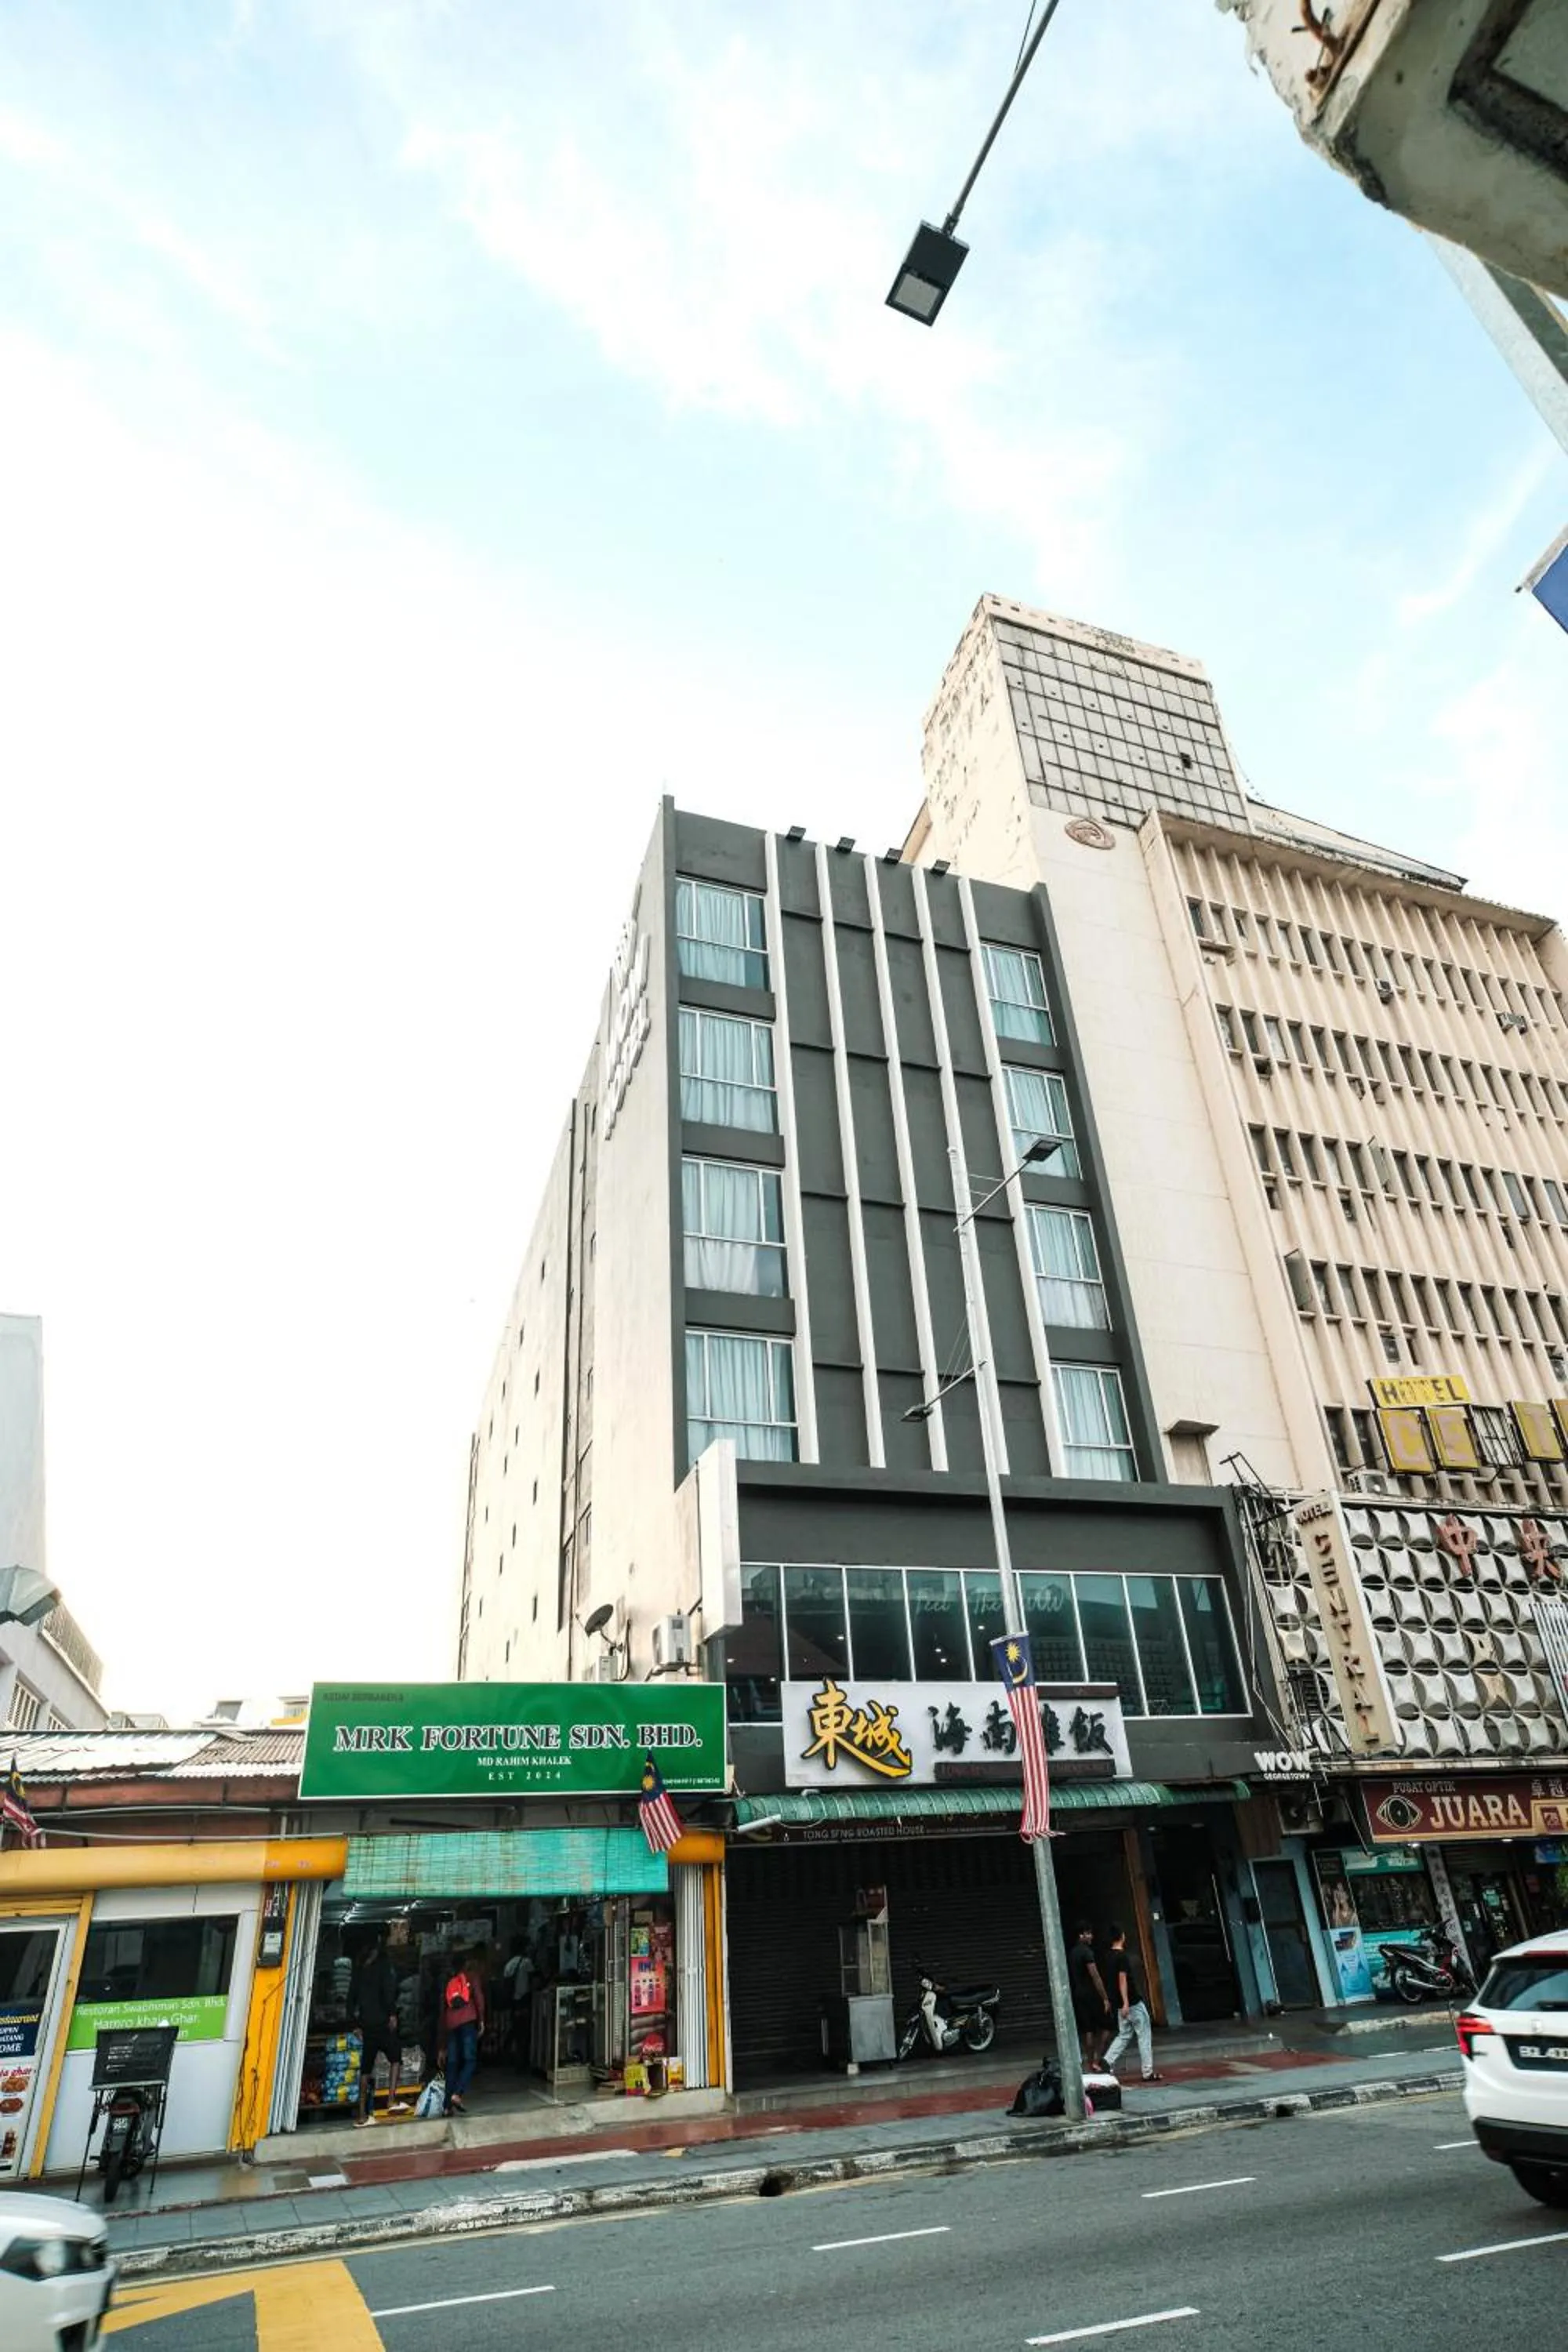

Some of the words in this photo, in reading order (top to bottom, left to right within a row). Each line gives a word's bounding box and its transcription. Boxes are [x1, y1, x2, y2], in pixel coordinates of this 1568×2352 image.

[332, 1725, 414, 1752] MRK
[420, 1724, 561, 1751] FORTUNE
[568, 1723, 631, 1750] SDN.
[637, 1723, 702, 1748] BHD.
[801, 1677, 913, 1779] 東城
[477, 1757, 494, 1766] MD
[495, 1756, 529, 1766] RAHIM
[1254, 1751, 1312, 1772] WOW
[1392, 1782, 1424, 1794] PUSAT
[1426, 1780, 1456, 1793] OPTIK
[1429, 1794, 1528, 1830] JUARA
